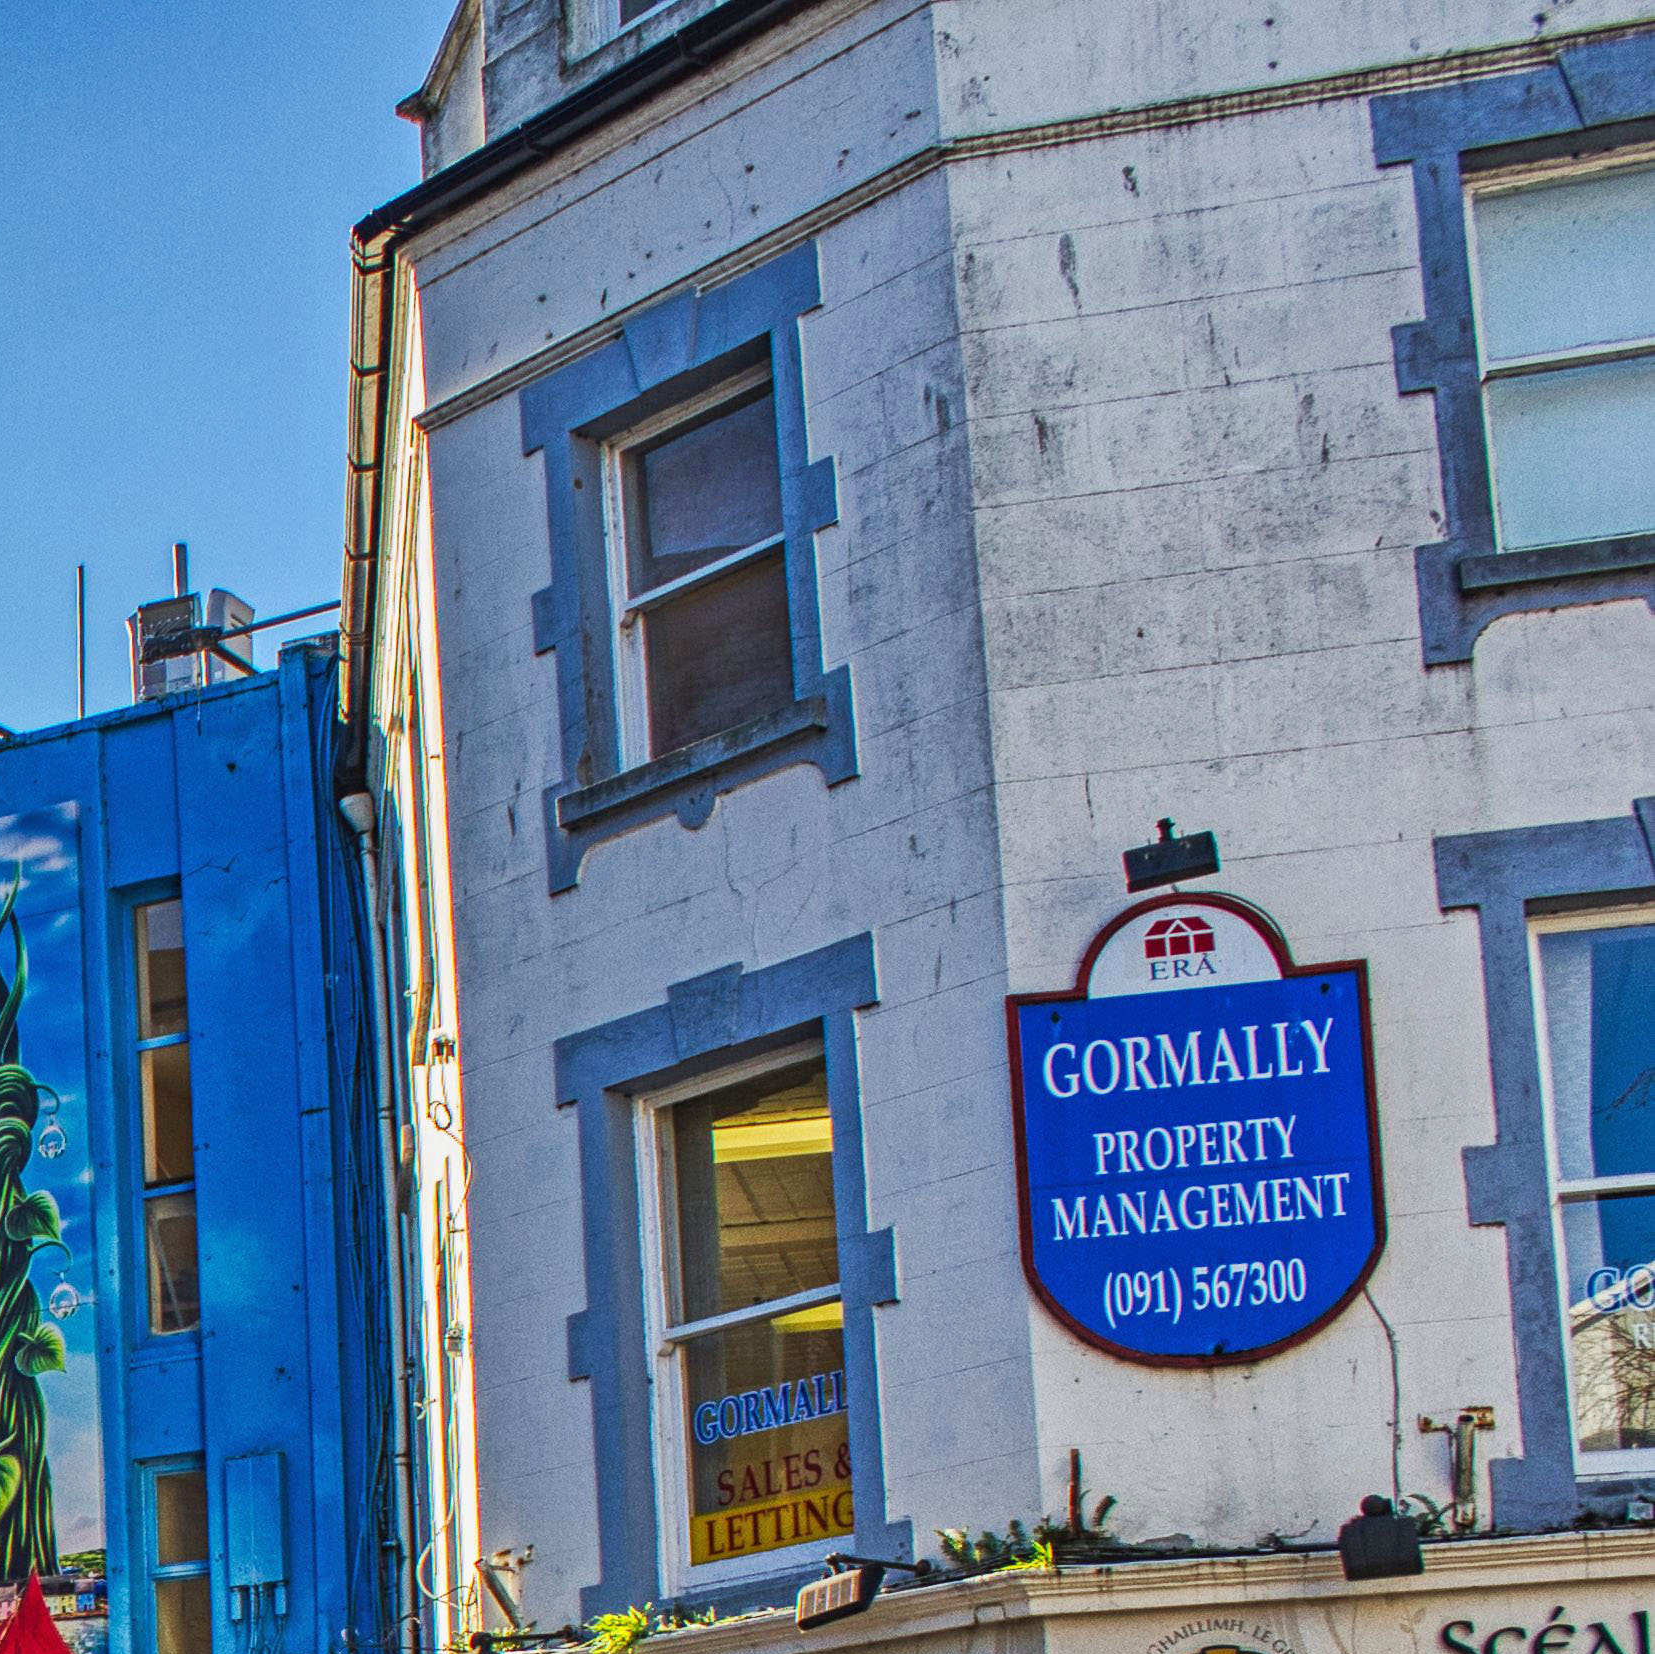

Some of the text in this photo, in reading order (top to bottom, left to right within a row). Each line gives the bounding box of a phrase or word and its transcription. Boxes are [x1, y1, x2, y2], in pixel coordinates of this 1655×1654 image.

[1042, 1017, 1334, 1099] GORMALLY
[1093, 1114, 1296, 1176] PROPERTY
[1051, 1172, 1350, 1241] MANAGEMENT
[1103, 1258, 1306, 1329] (091) 567300
[717, 1442, 852, 1506] SALES &
